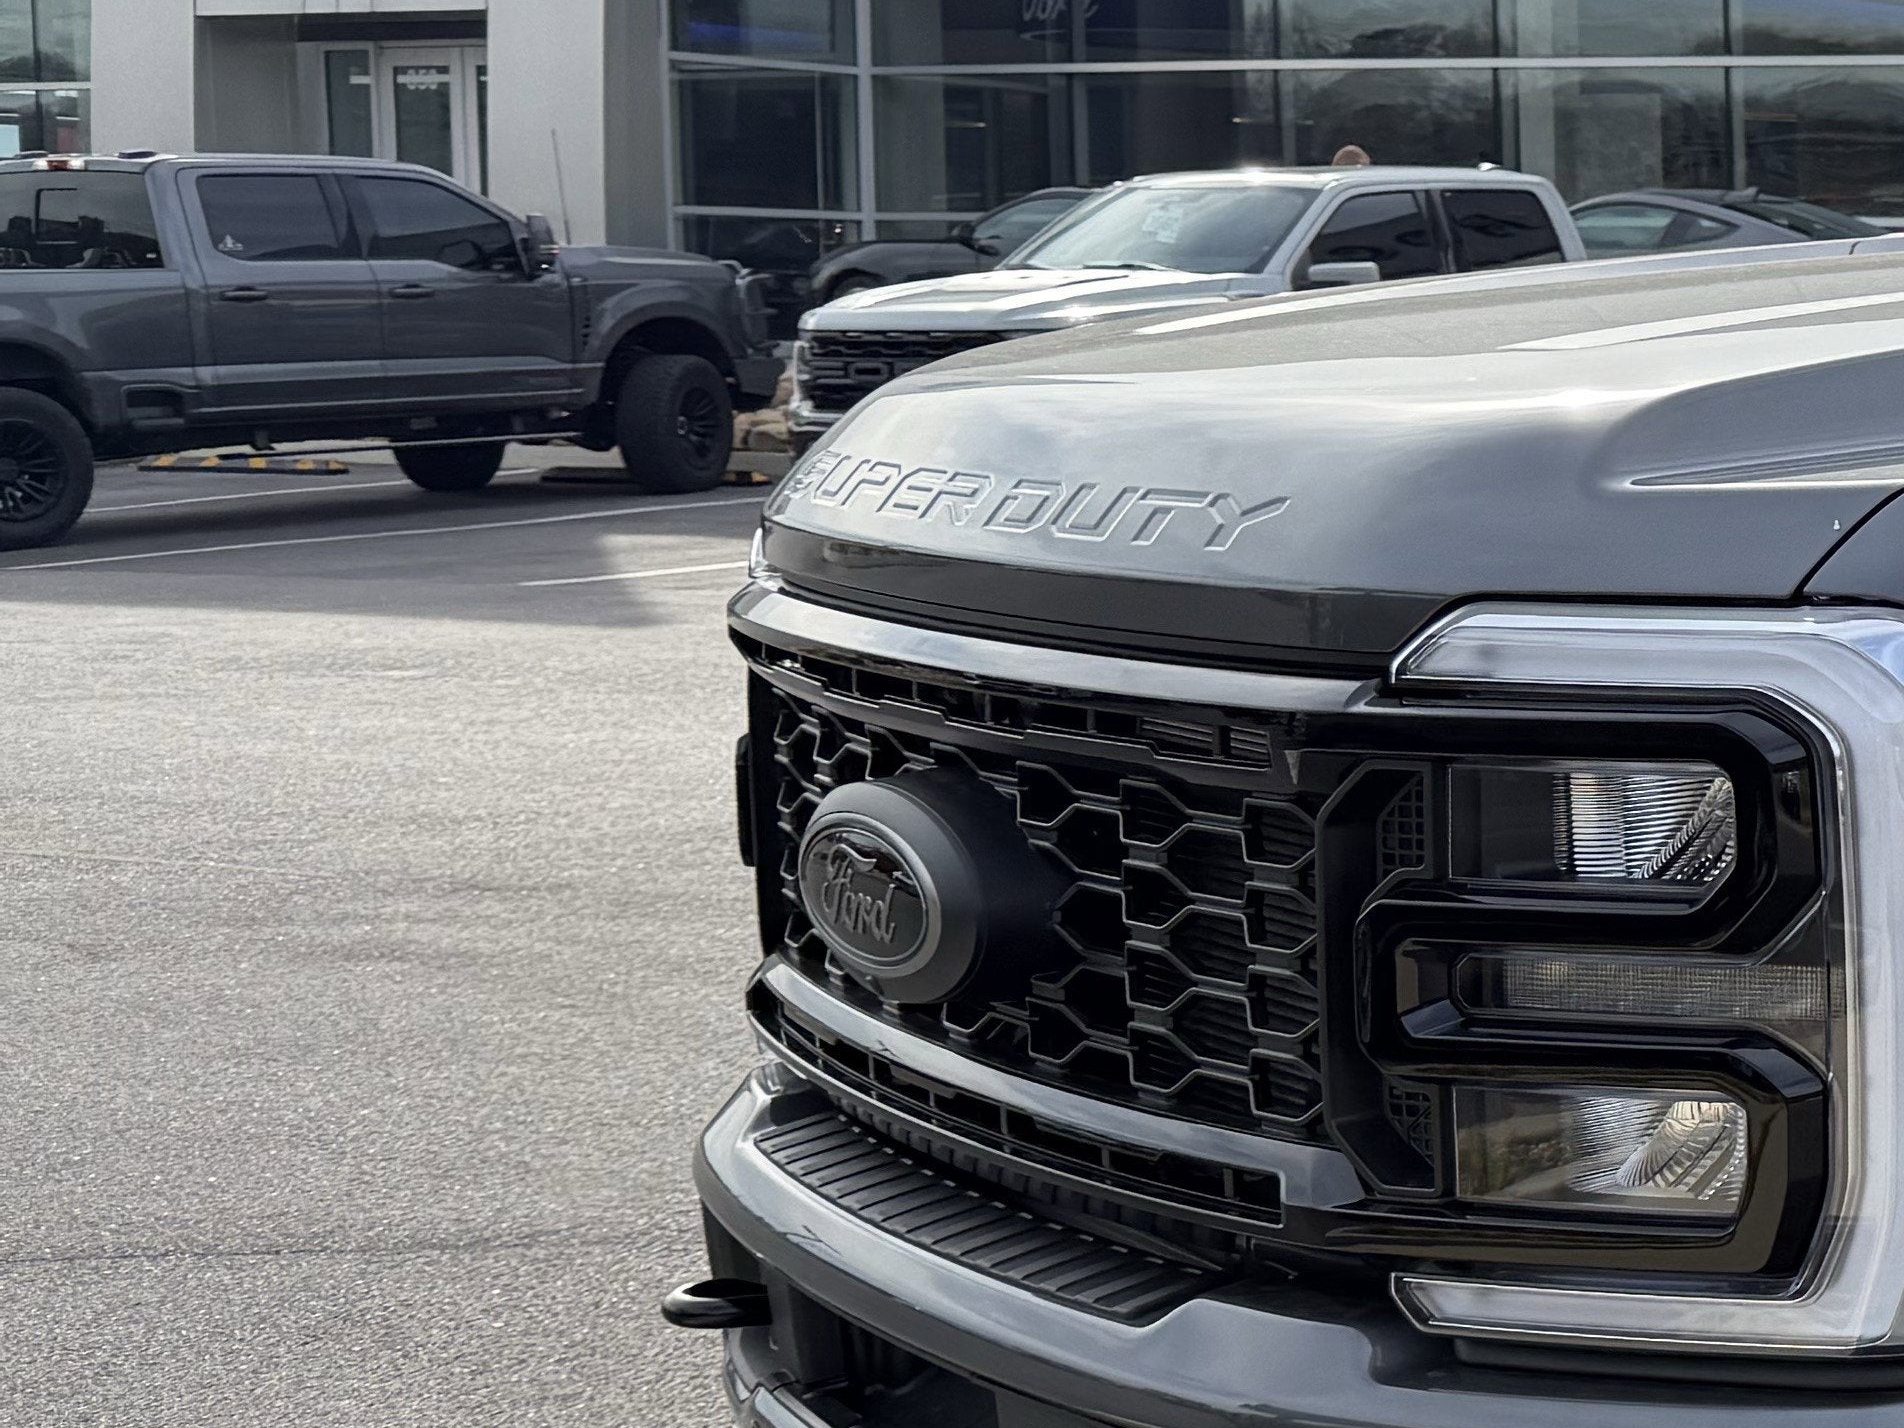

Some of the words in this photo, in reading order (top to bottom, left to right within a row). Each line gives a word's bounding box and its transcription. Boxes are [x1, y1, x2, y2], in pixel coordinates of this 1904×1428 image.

[785, 453, 996, 527] SUPER
[983, 478, 1292, 551] DUTY
[822, 843, 896, 943] Ford
